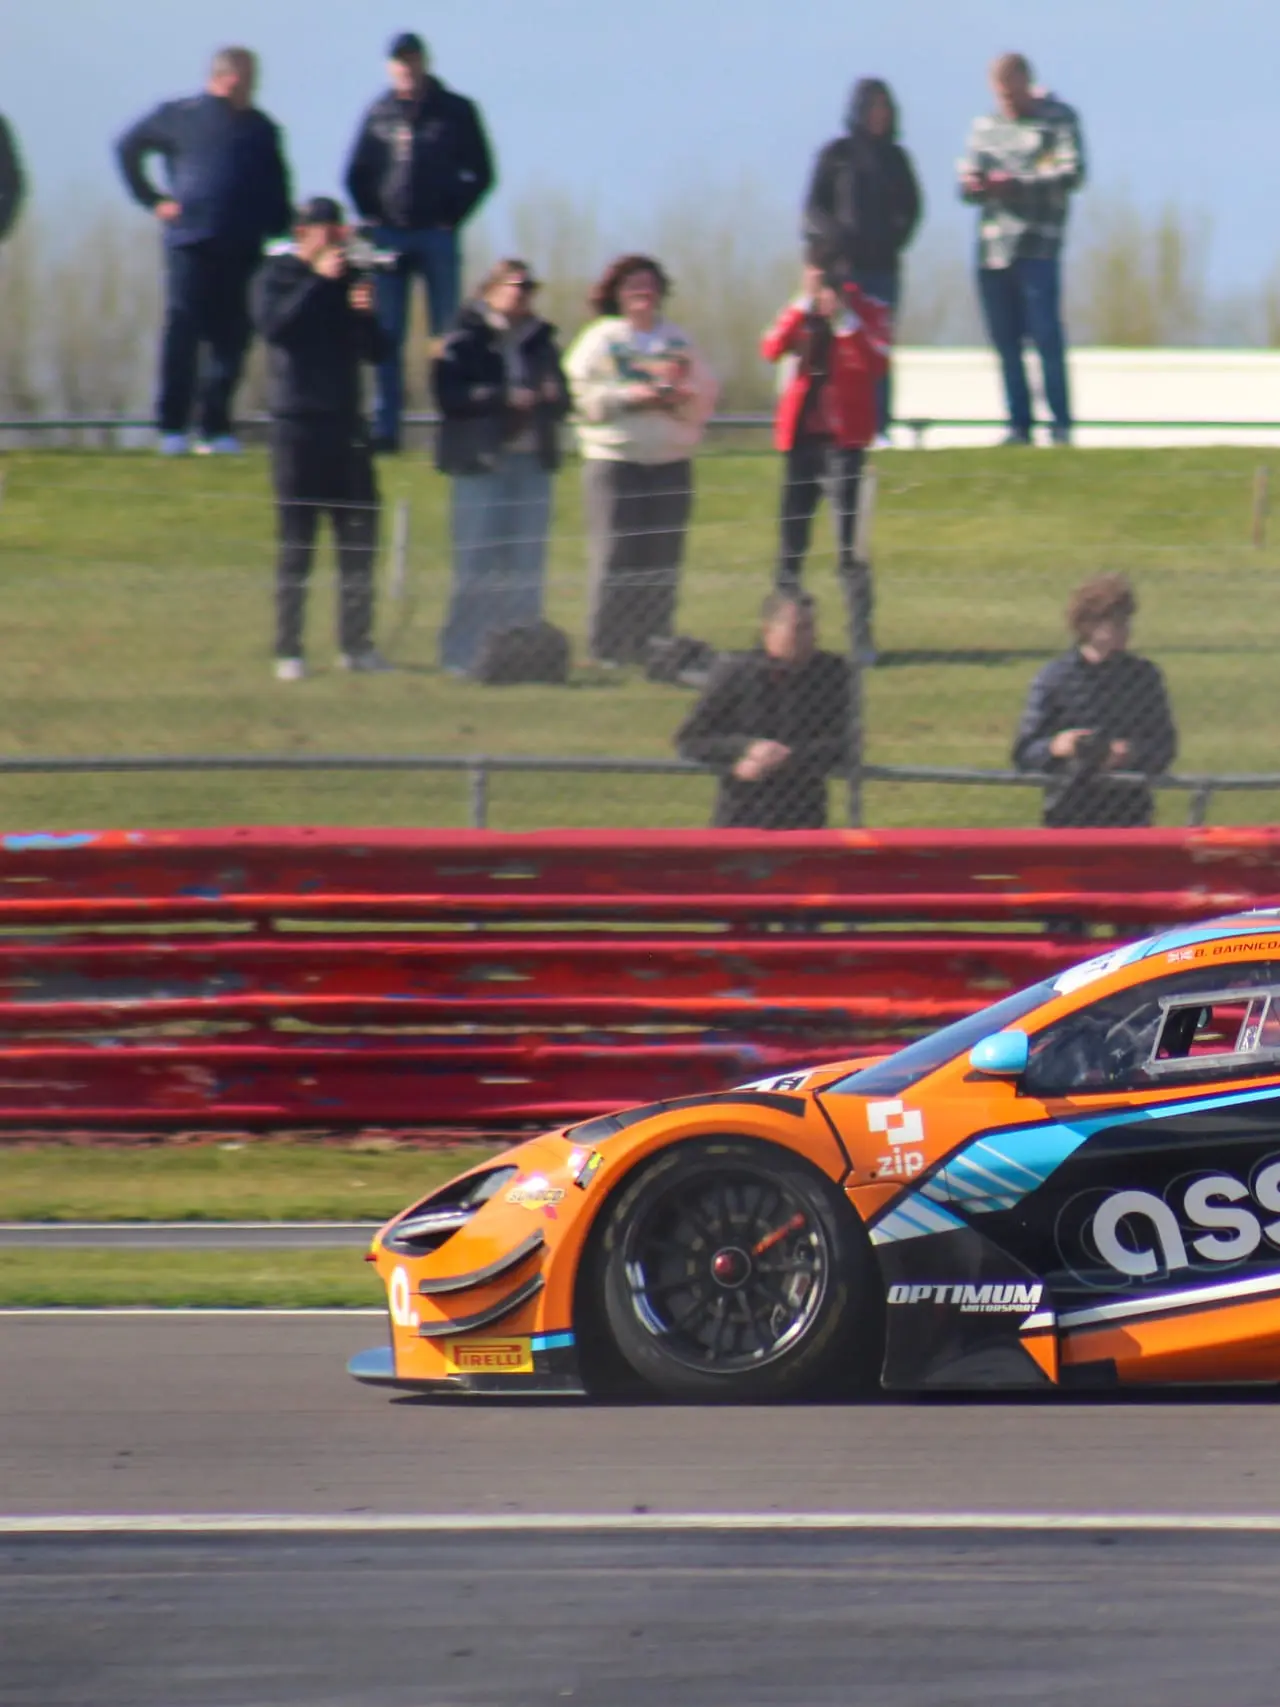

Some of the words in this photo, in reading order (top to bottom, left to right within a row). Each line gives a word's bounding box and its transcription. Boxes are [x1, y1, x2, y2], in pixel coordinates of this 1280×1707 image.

[876, 1147, 924, 1177] zip
[887, 1283, 1043, 1304] OPTIMUM
[959, 1304, 1038, 1313] MOTORSPORT
[454, 1344, 522, 1366] PIRELLI
